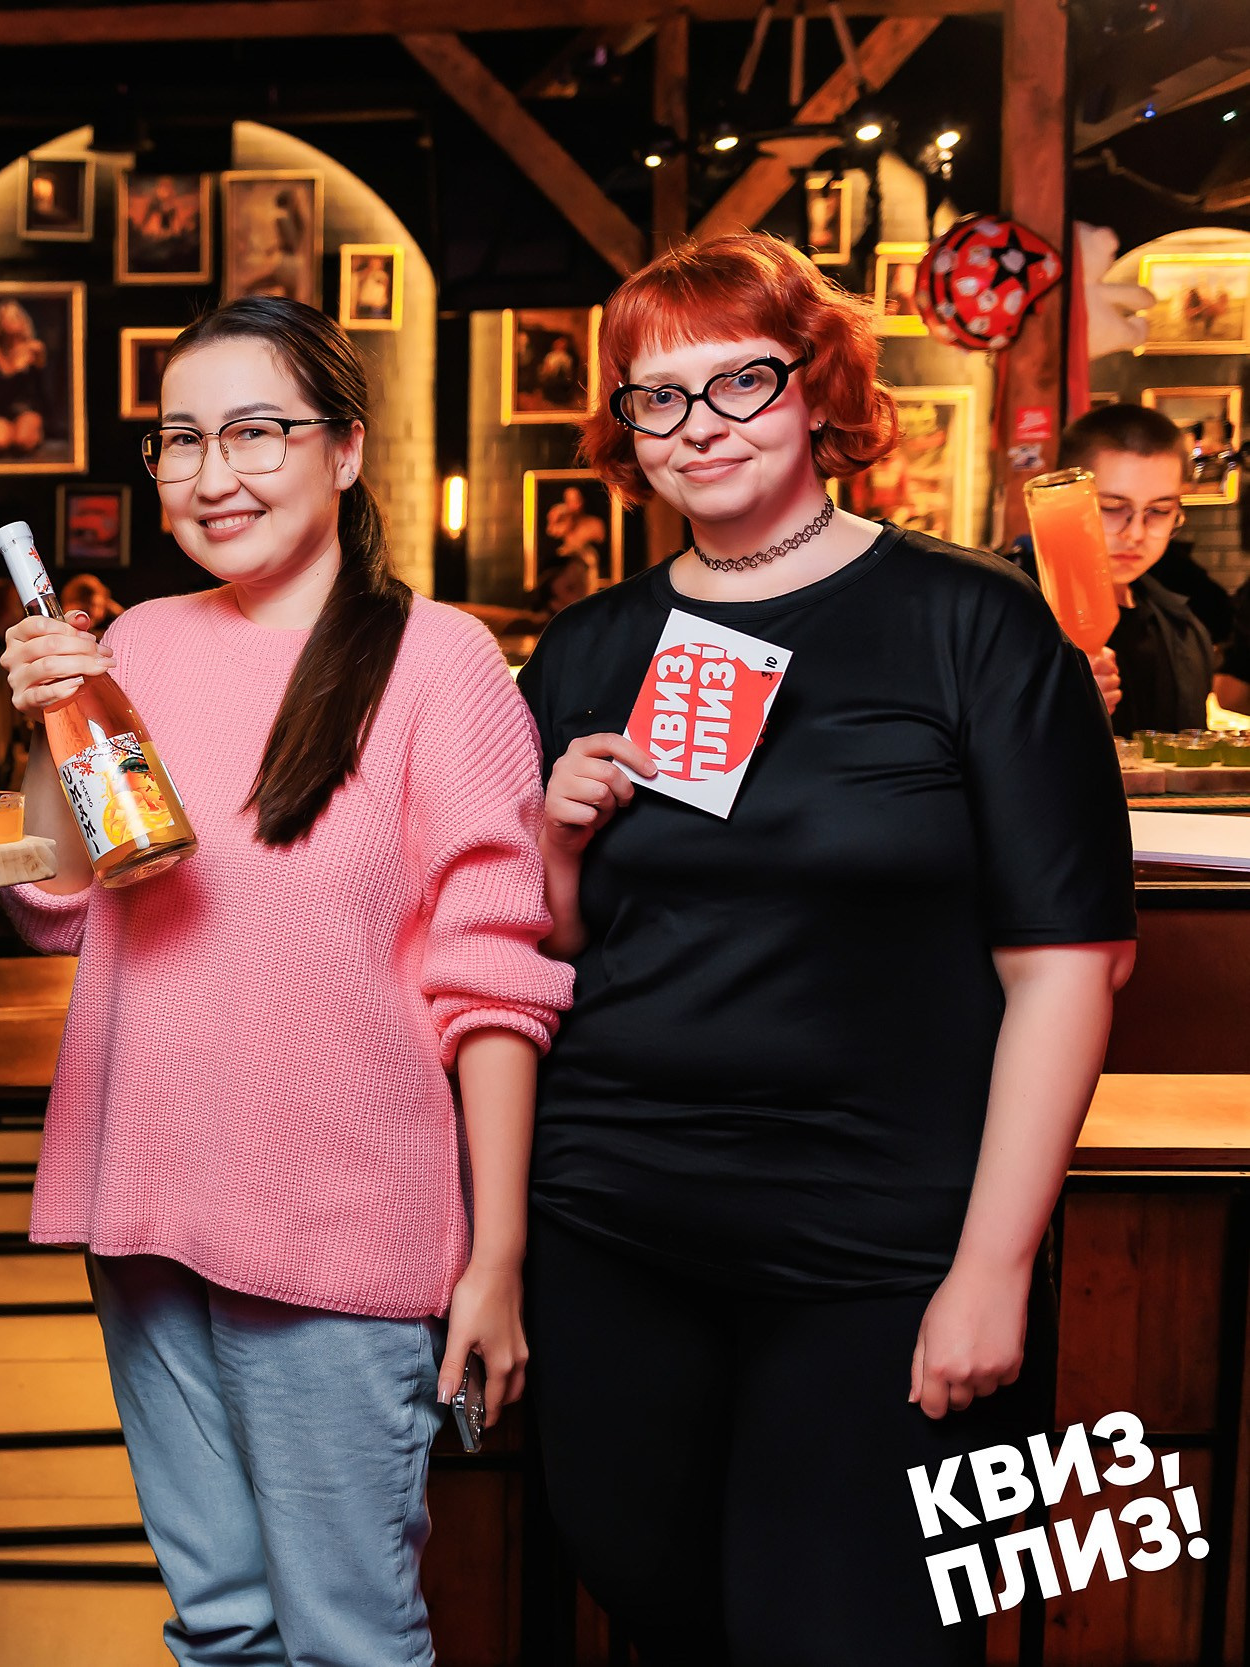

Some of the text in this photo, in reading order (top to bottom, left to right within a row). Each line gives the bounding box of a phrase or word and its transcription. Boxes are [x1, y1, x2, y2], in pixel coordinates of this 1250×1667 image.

[650, 643, 701, 773] КВИЗ,
[690, 646, 737, 780] ПЛИЗ!
[62, 766, 100, 854] UMAMI
